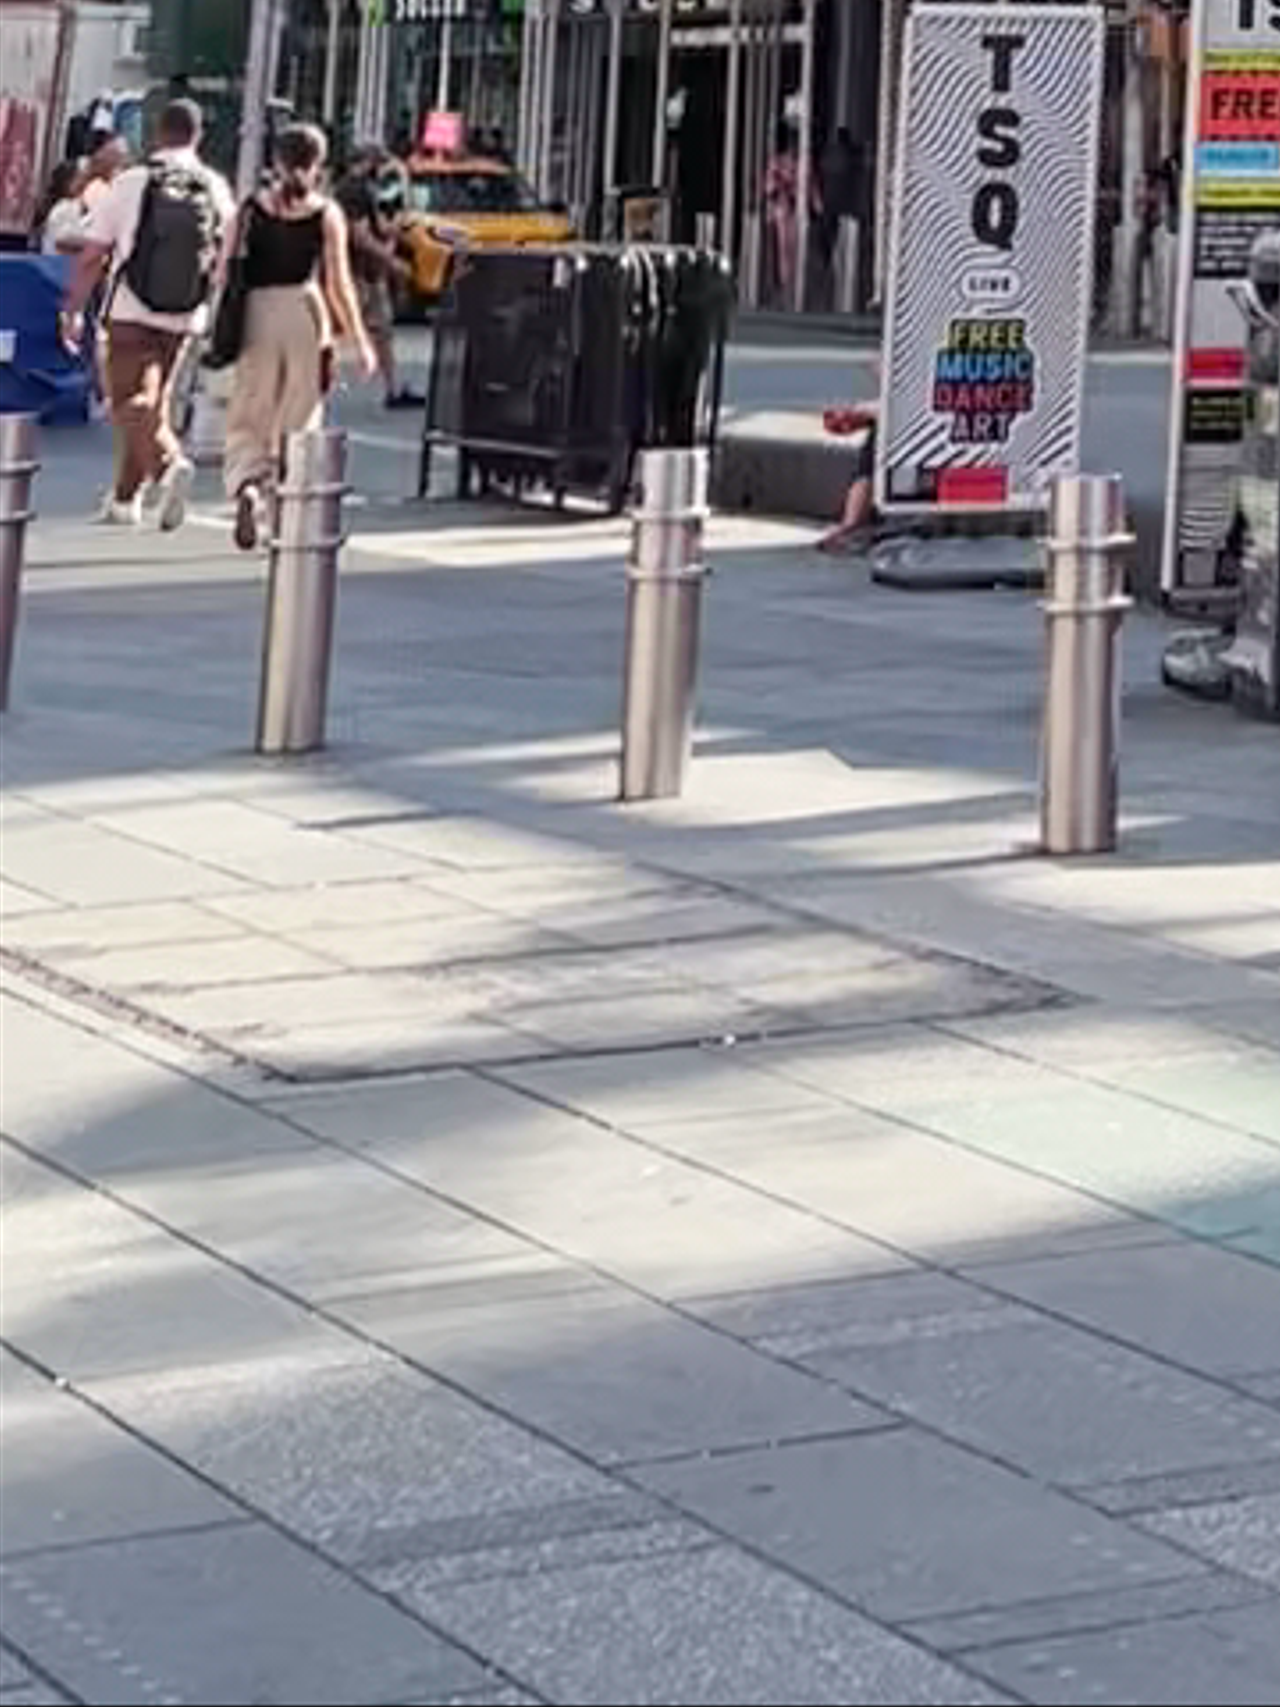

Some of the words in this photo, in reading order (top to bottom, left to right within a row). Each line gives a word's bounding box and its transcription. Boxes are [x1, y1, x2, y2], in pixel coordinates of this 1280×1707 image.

[970, 34, 1025, 253] TSQ
[953, 321, 1025, 349] FREE
[939, 352, 1033, 379] MUSIC
[936, 382, 1033, 411] DANCE
[954, 412, 1012, 443] ART
